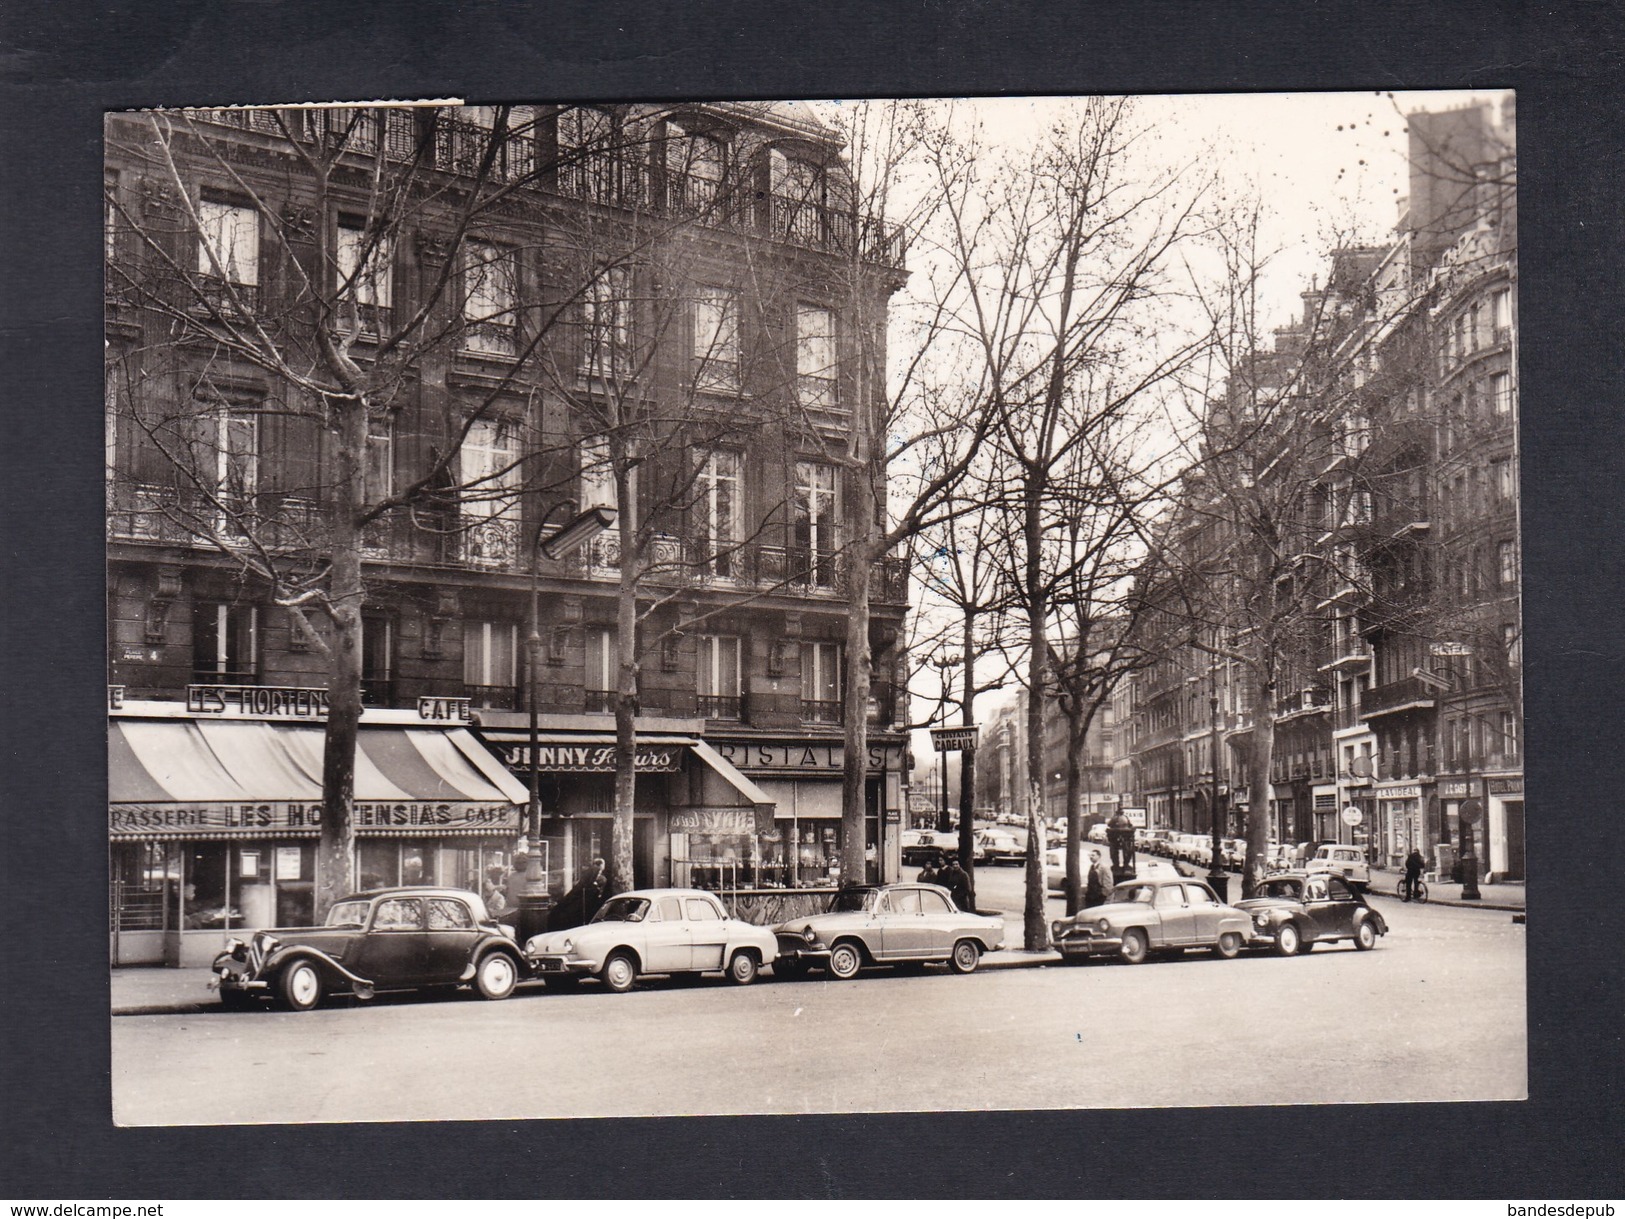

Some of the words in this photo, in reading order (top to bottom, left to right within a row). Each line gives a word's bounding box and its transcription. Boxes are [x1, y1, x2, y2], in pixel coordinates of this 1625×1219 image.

[150, 650, 158, 660] 4
[187, 687, 227, 713] LES
[418, 699, 471, 721] CAFE
[935, 737, 975, 751] CADEAUX
[719, 744, 883, 769] RISTALS
[225, 805, 271, 828] LES
[288, 804, 451, 827] HOENSIAS
[465, 807, 507, 823] CAFE
